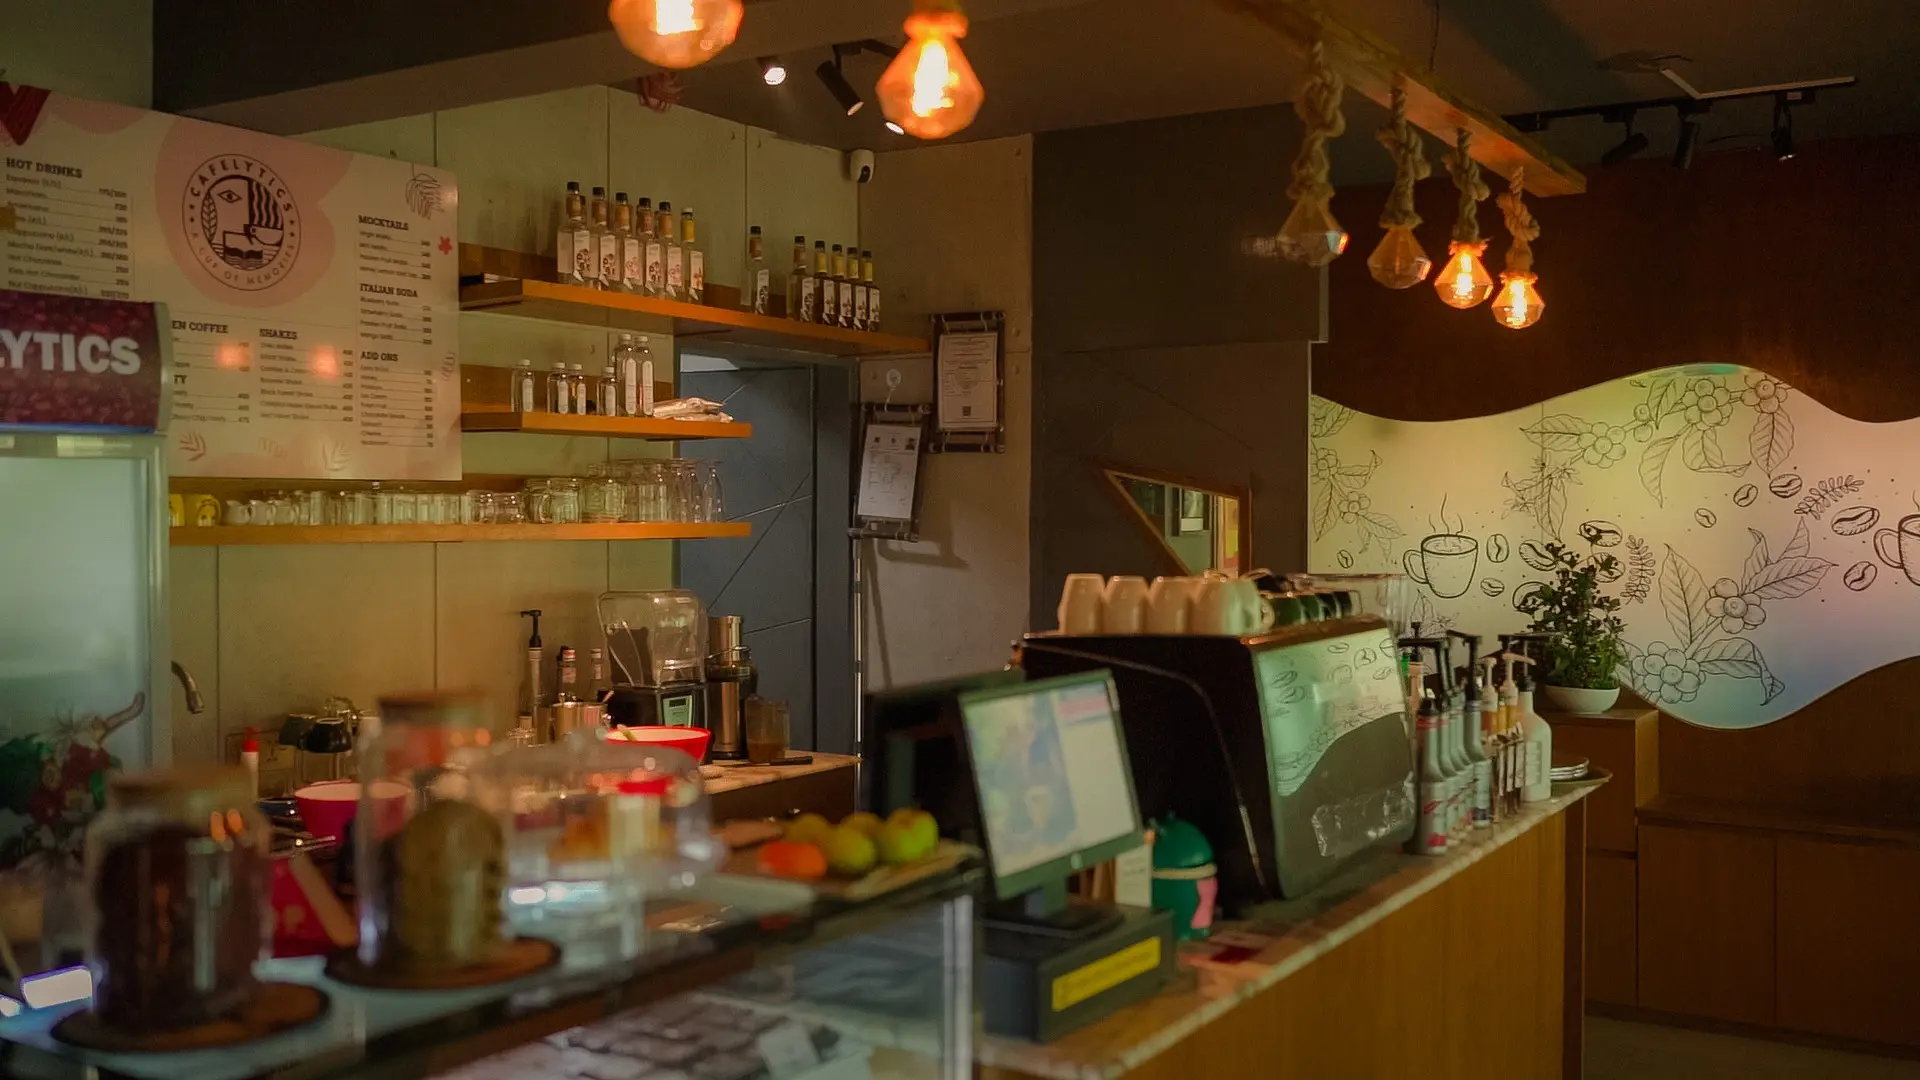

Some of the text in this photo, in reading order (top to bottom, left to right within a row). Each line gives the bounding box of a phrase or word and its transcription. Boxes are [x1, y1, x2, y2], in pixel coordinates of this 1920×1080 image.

[6, 157, 83, 179] HOT DRINKS
[190, 158, 294, 212] CAFELYTICS
[357, 214, 409, 231] MOCKTAILS
[360, 282, 419, 298] ITALIAN SODA
[189, 321, 229, 334] COFFEE
[259, 328, 298, 340] SHAKES
[0, 328, 141, 375] YTICS
